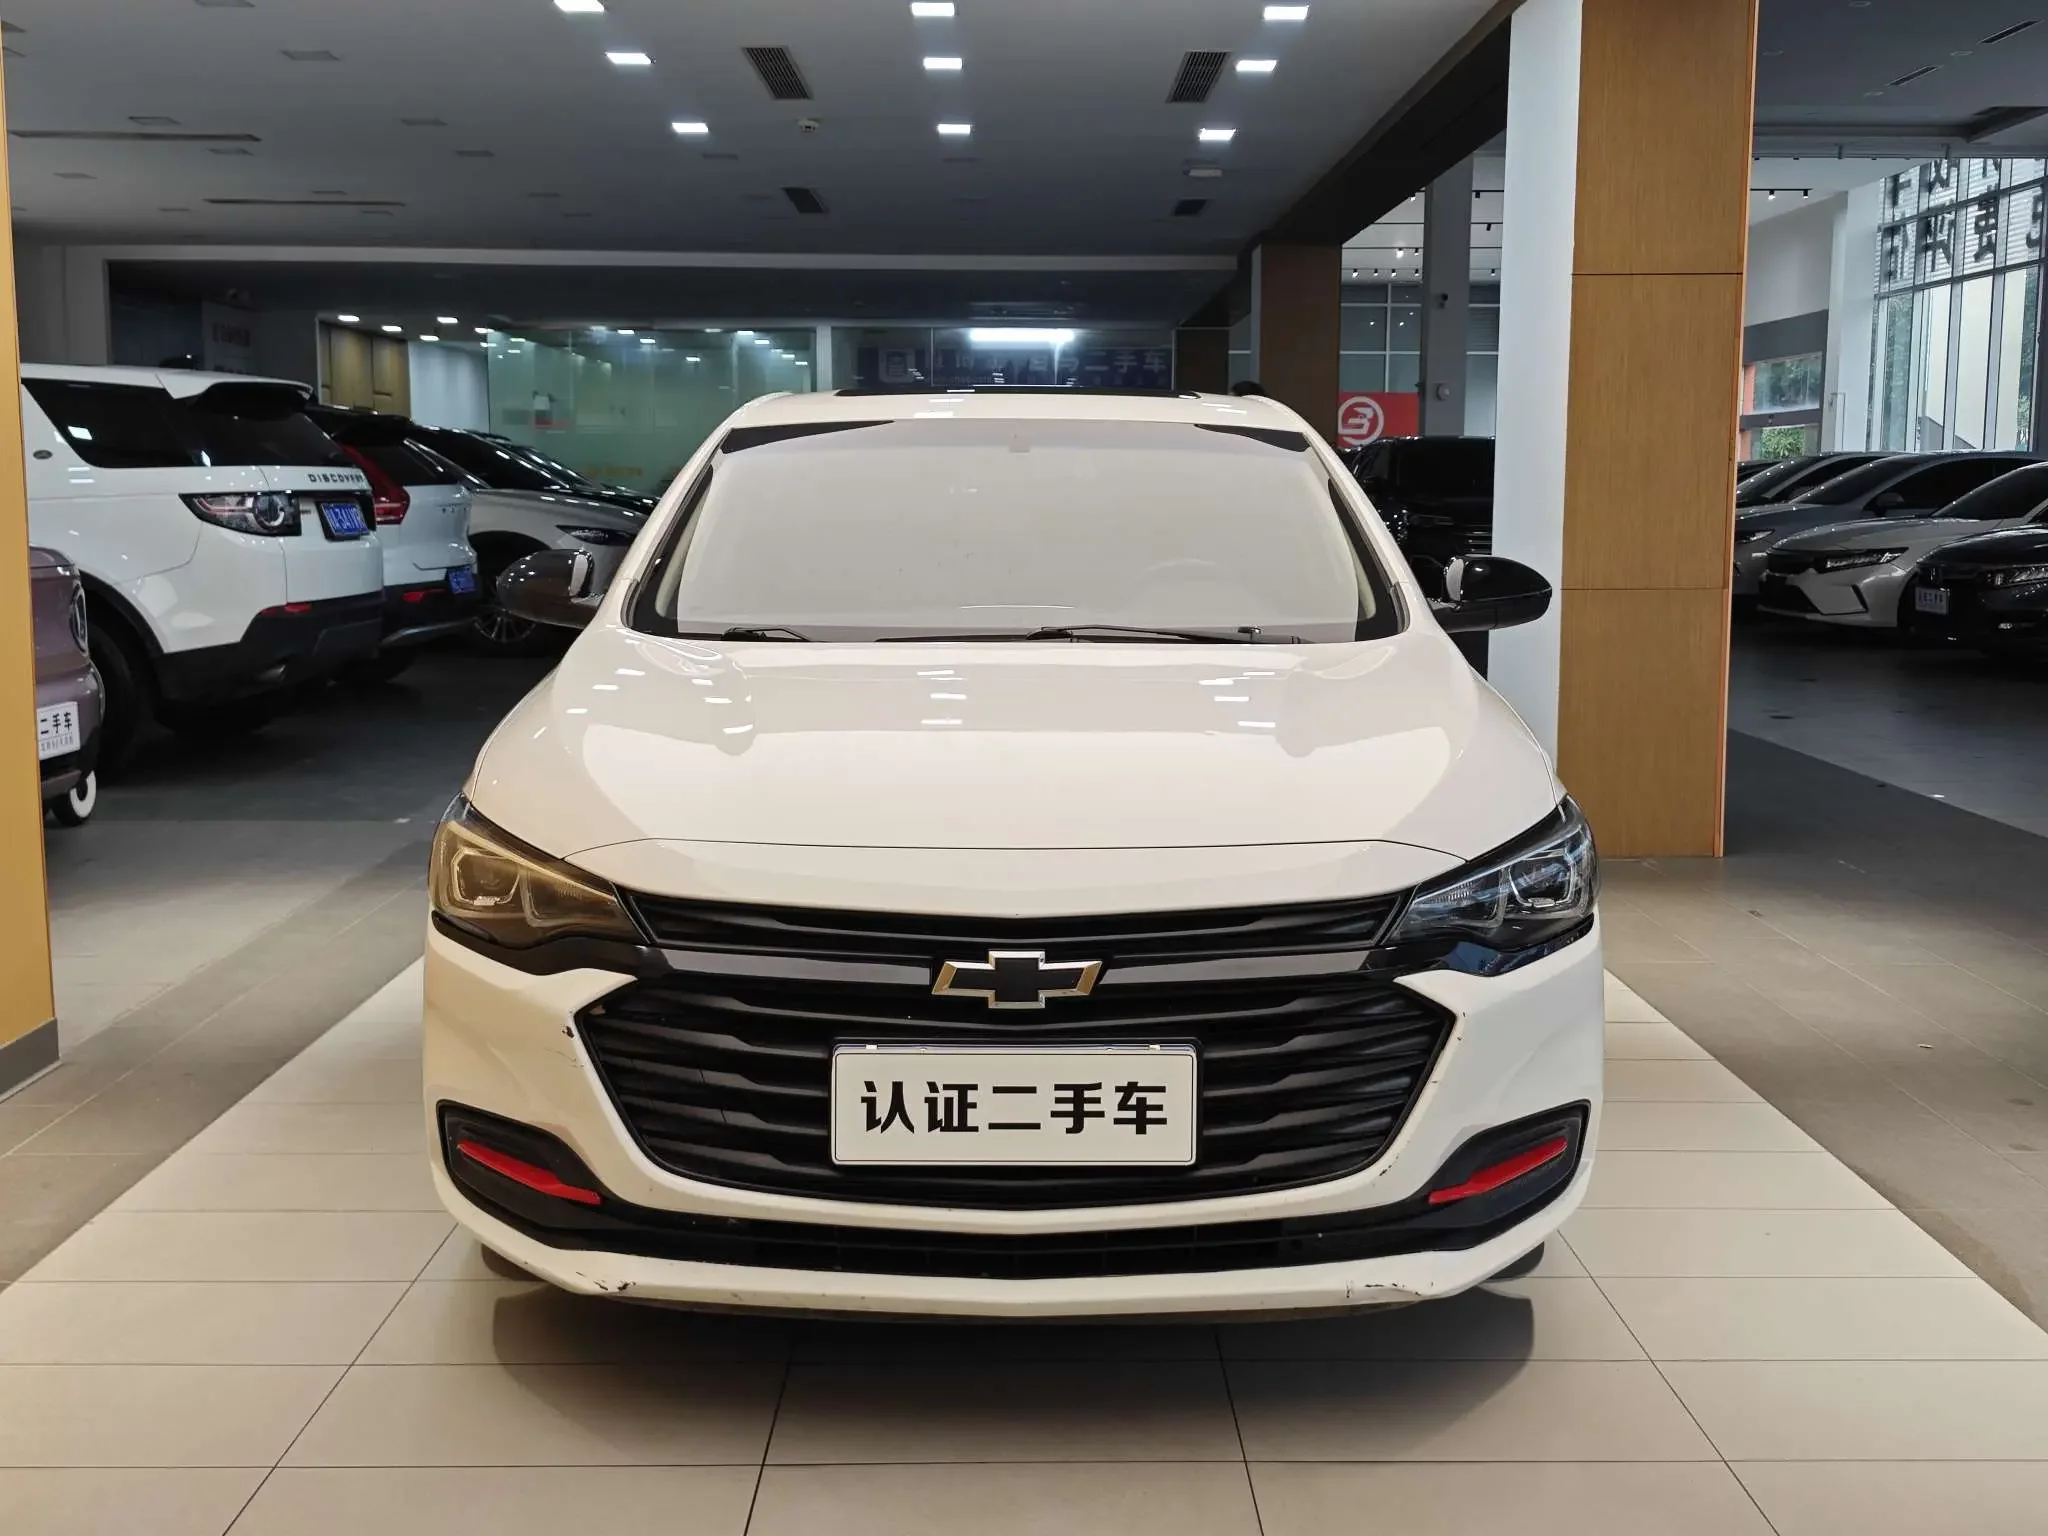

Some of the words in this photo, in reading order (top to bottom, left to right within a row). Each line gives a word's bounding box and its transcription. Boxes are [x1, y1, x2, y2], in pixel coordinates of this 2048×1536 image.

[40, 712, 72, 735] 二手车
[860, 1080, 1168, 1135] 认证二手车
